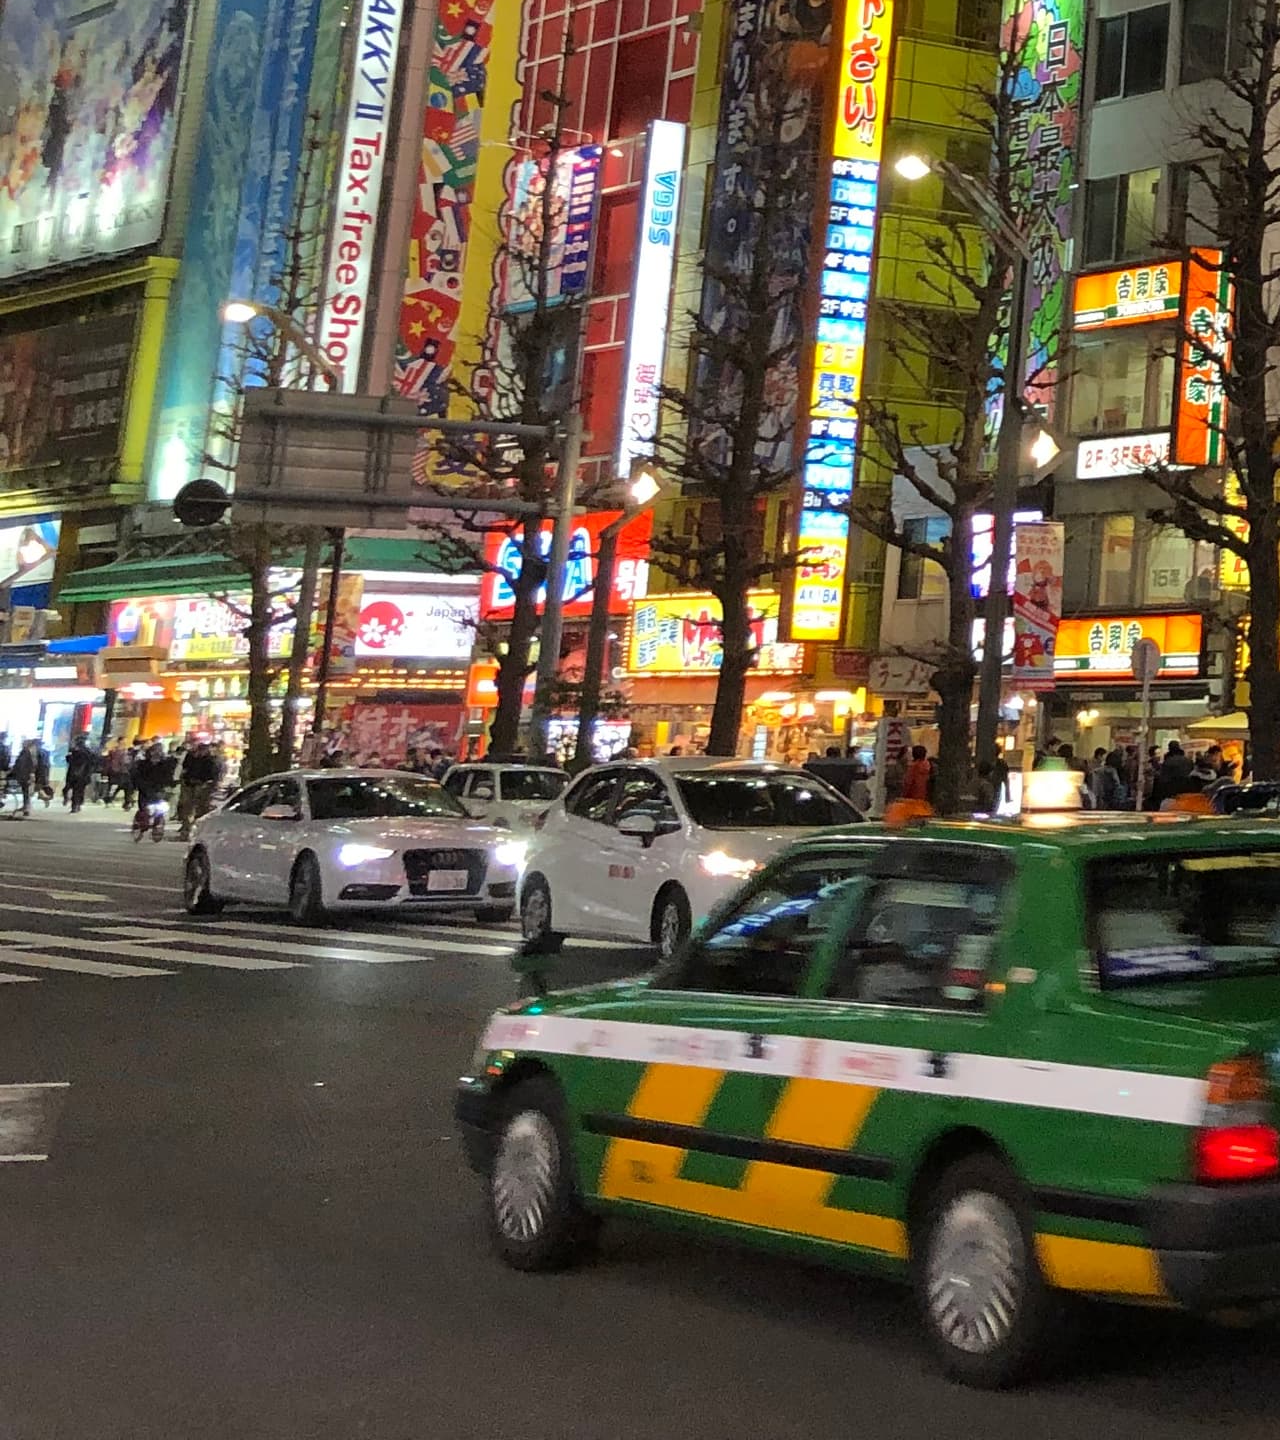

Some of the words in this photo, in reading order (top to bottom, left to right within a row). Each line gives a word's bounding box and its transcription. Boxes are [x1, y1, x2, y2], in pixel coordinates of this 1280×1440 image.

[333, 130, 383, 287] Tax-free
[648, 170, 678, 246] SEGA
[492, 526, 594, 608] SA
